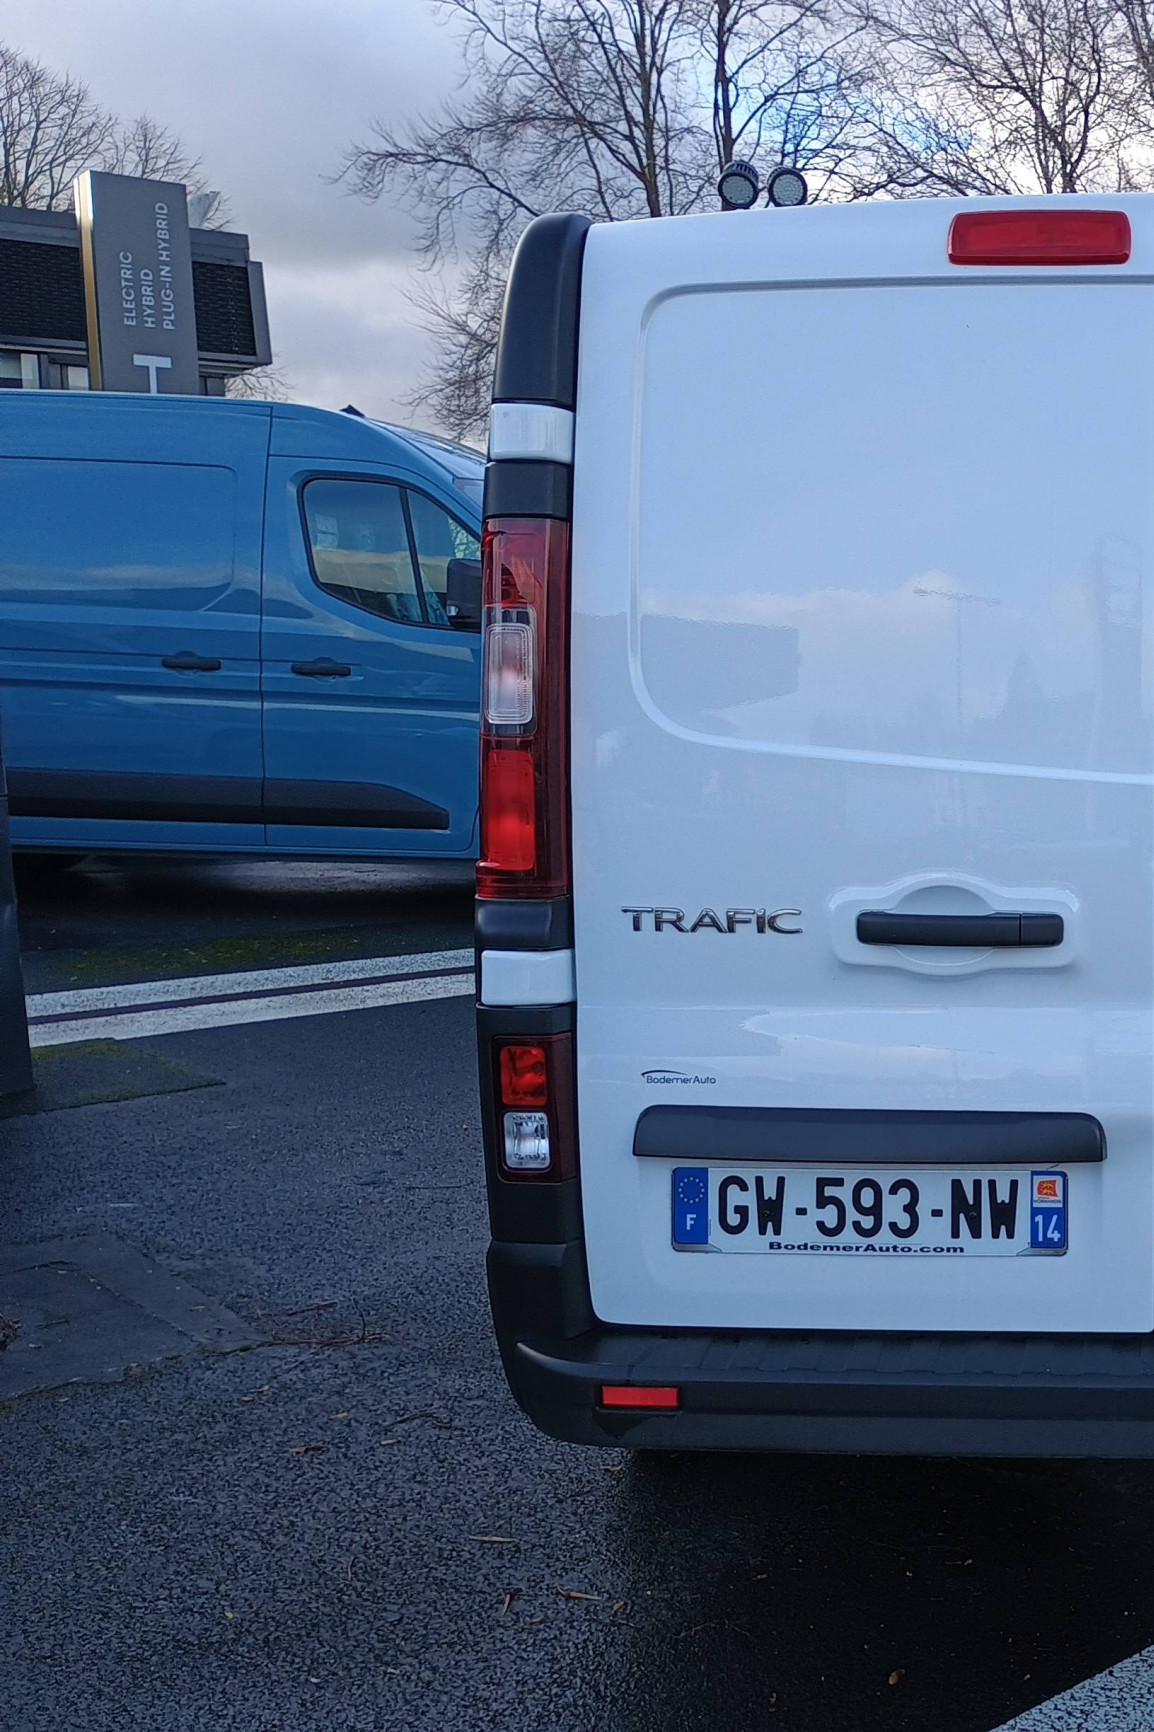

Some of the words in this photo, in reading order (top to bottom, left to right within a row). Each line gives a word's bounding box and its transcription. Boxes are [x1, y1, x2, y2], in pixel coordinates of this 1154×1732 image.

[155, 202, 173, 261] HYBRID
[119, 251, 137, 326] ELECTRIC
[140, 268, 156, 328] HYBRID
[160, 265, 176, 330] PLUG-IN
[621, 906, 803, 934] TRAFIC
[686, 1214, 697, 1230] F
[718, 1175, 1019, 1239] GW-593-NW
[1034, 1214, 1061, 1242] 14
[769, 1241, 964, 1254] BodemerAuto.com
